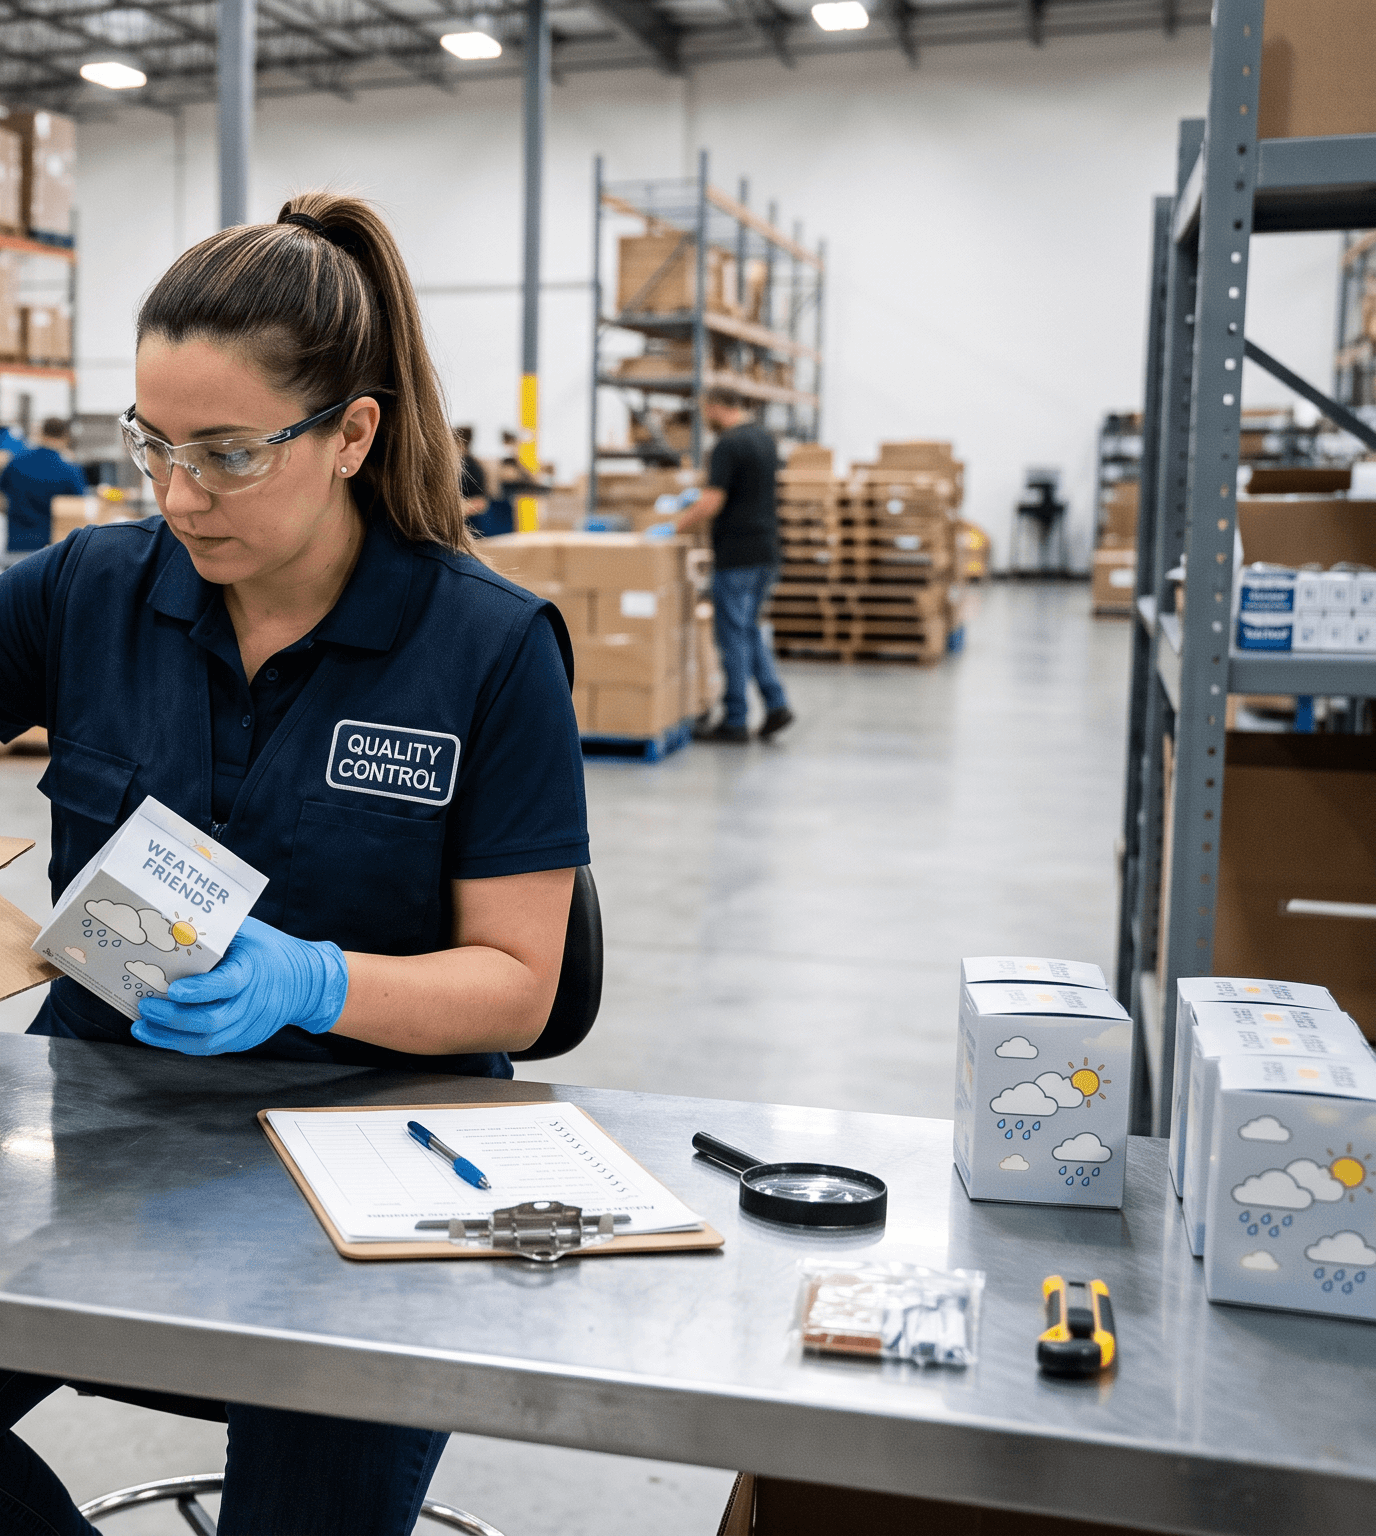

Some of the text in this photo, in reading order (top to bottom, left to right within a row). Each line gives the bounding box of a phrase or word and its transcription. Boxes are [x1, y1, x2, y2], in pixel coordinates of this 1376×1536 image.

[347, 734, 442, 765] QUALITY
[338, 759, 442, 792] CONTROL
[142, 857, 215, 914] FRIENDS
[147, 839, 230, 905] WEATHER
